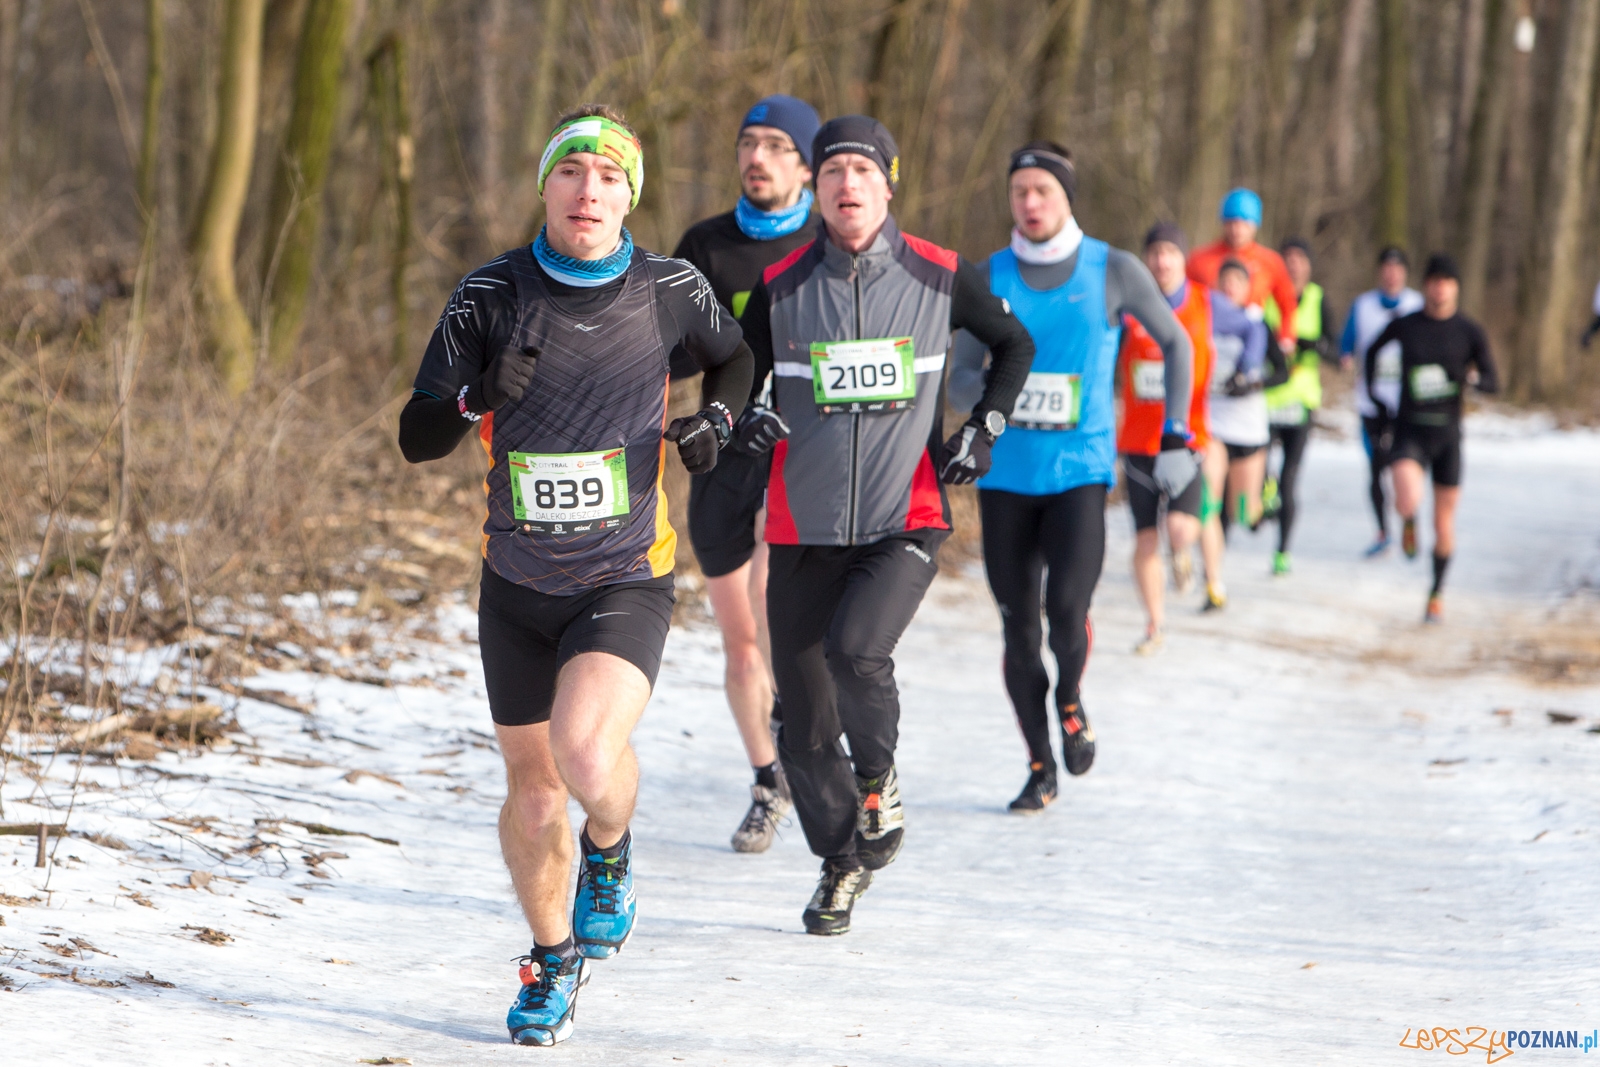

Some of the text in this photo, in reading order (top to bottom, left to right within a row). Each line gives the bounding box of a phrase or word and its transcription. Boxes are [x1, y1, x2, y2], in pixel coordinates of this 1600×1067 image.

[828, 363, 896, 390] 2109
[1019, 389, 1063, 412] 278
[535, 477, 604, 509] 839
[535, 511, 567, 521] DALEKO
